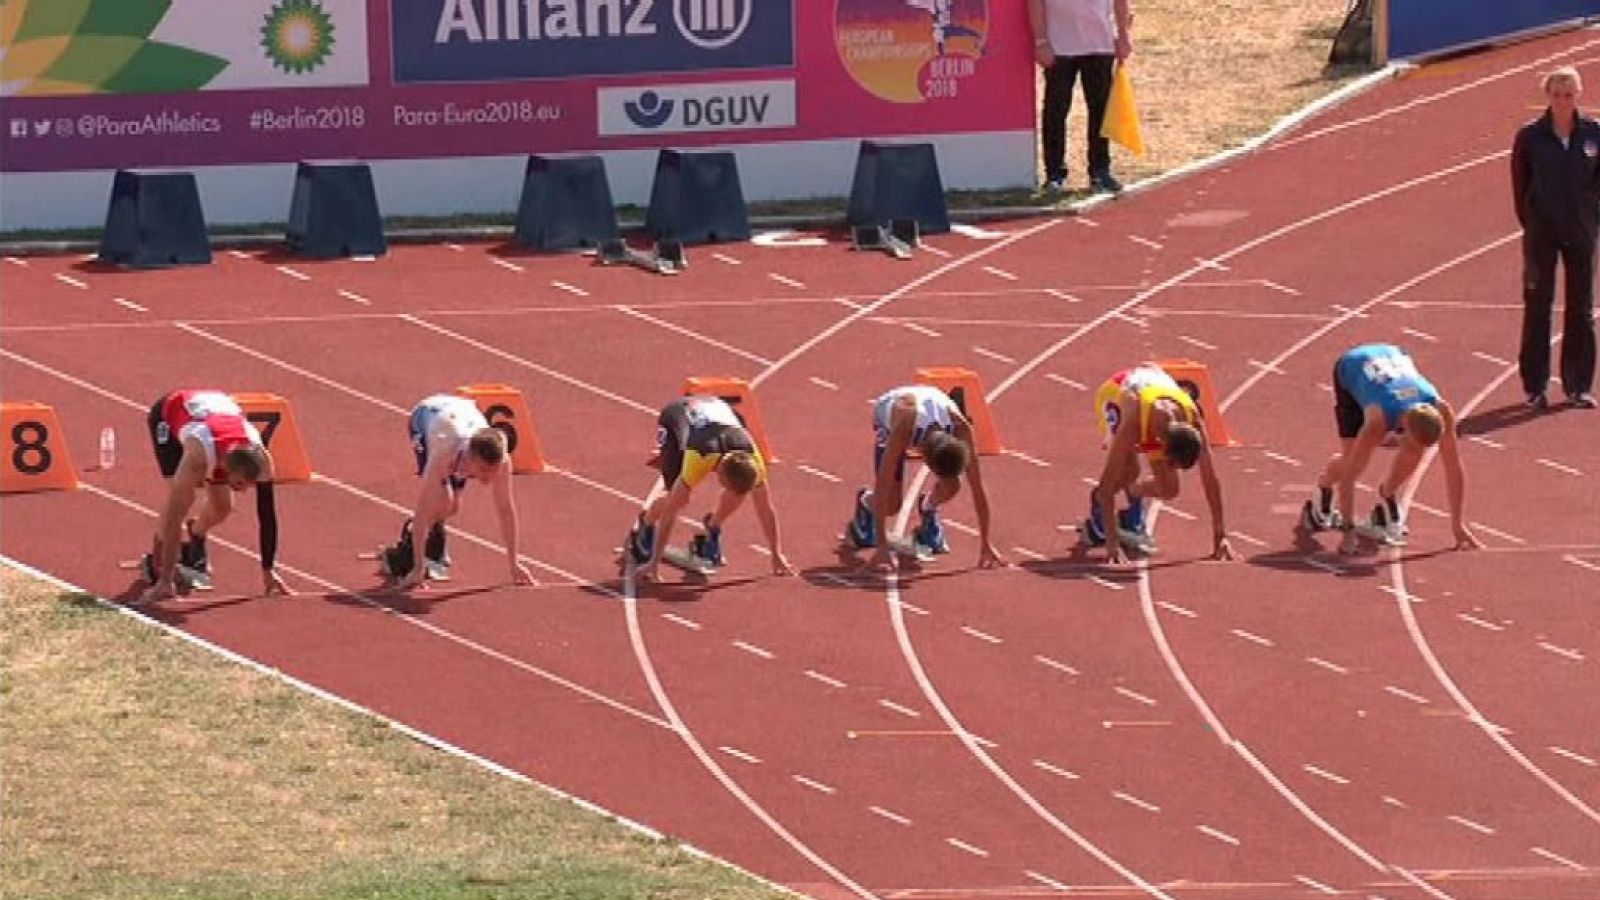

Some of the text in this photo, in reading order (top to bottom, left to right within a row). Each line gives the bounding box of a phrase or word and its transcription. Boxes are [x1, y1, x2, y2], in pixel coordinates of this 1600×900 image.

[434, 0, 657, 43] Allianz
[930, 57, 976, 78] BERLIN
[924, 77, 958, 98] 2018
[77, 111, 220, 138] @ParaAthletics
[249, 105, 365, 130] #Berlin2018
[393, 101, 561, 126] Para-Euro2018.eu
[682, 93, 770, 127] DGUV
[247, 411, 281, 447] 7
[485, 404, 518, 454] 6
[11, 421, 51, 475] 8
